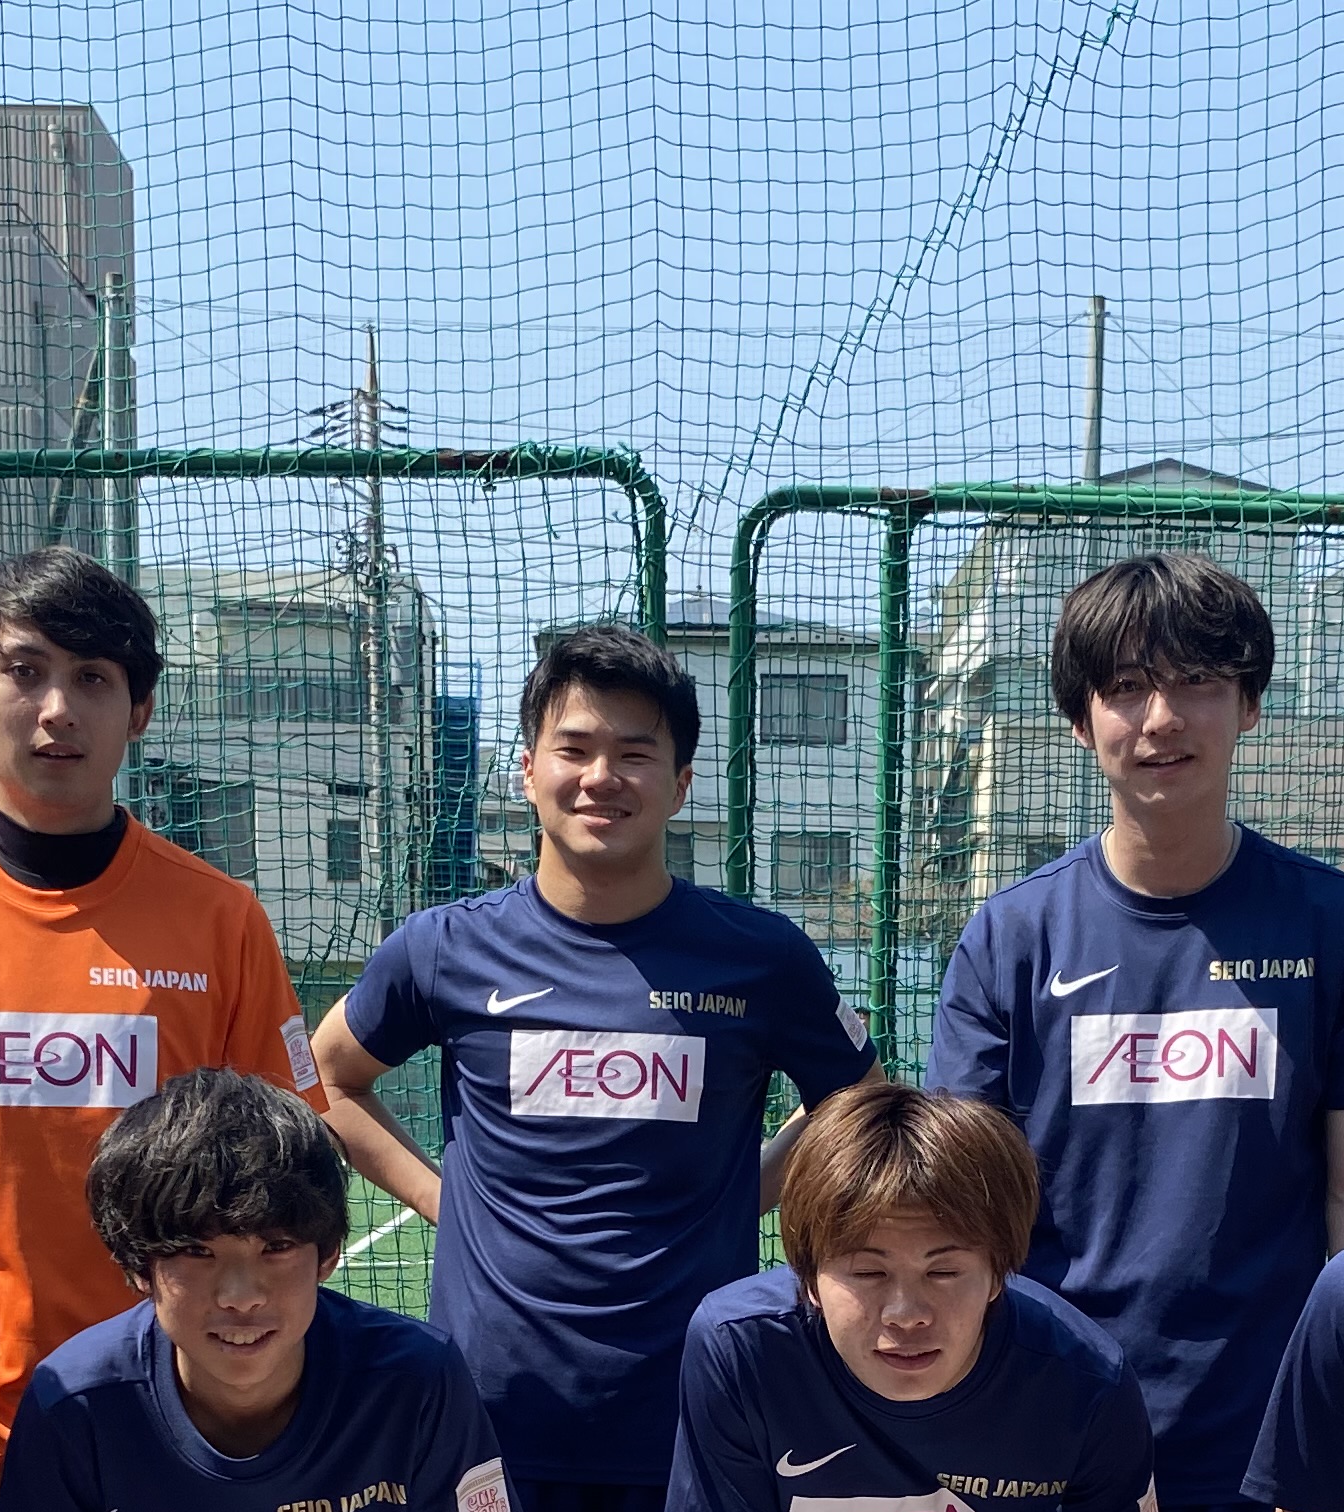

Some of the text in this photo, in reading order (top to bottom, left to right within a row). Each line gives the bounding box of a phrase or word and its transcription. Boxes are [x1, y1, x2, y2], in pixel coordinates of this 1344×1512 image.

[89, 967, 208, 993] SEIQ JAPAN
[1209, 959, 1256, 982] SEIQ
[649, 990, 747, 1018] SEIQ JAPAN
[936, 1472, 989, 1499] SEIQ
